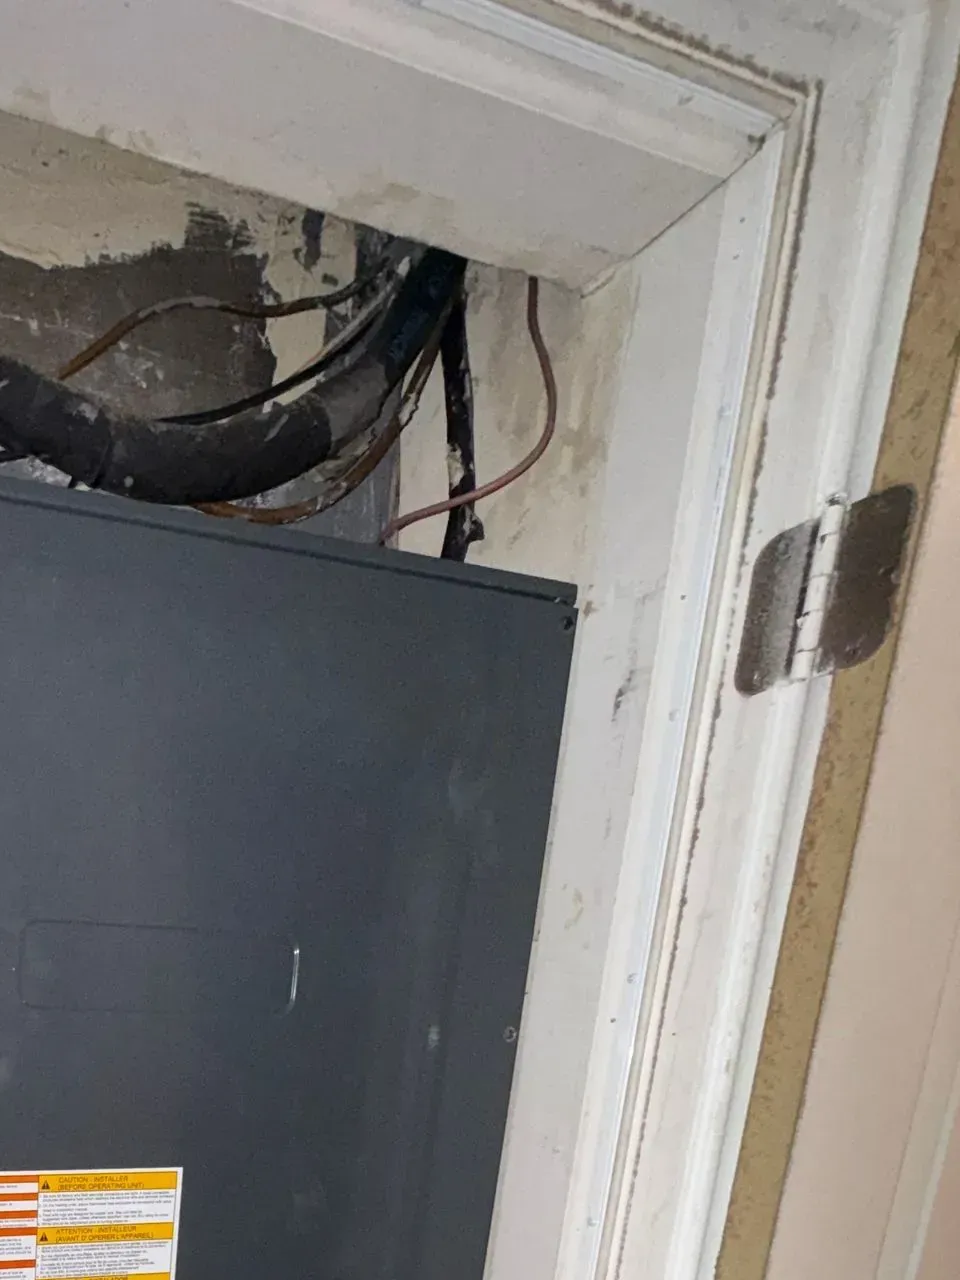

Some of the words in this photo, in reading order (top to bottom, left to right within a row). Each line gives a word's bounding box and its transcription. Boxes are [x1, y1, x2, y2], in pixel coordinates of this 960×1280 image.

[58, 1175, 88, 1183] CAUTION
[58, 1183, 86, 1191] (BEFORE
[88, 1182, 123, 1190] OPERATING
[98, 1225, 136, 1233] INSTALLEUR
[55, 1235, 78, 1243] (AVANT
